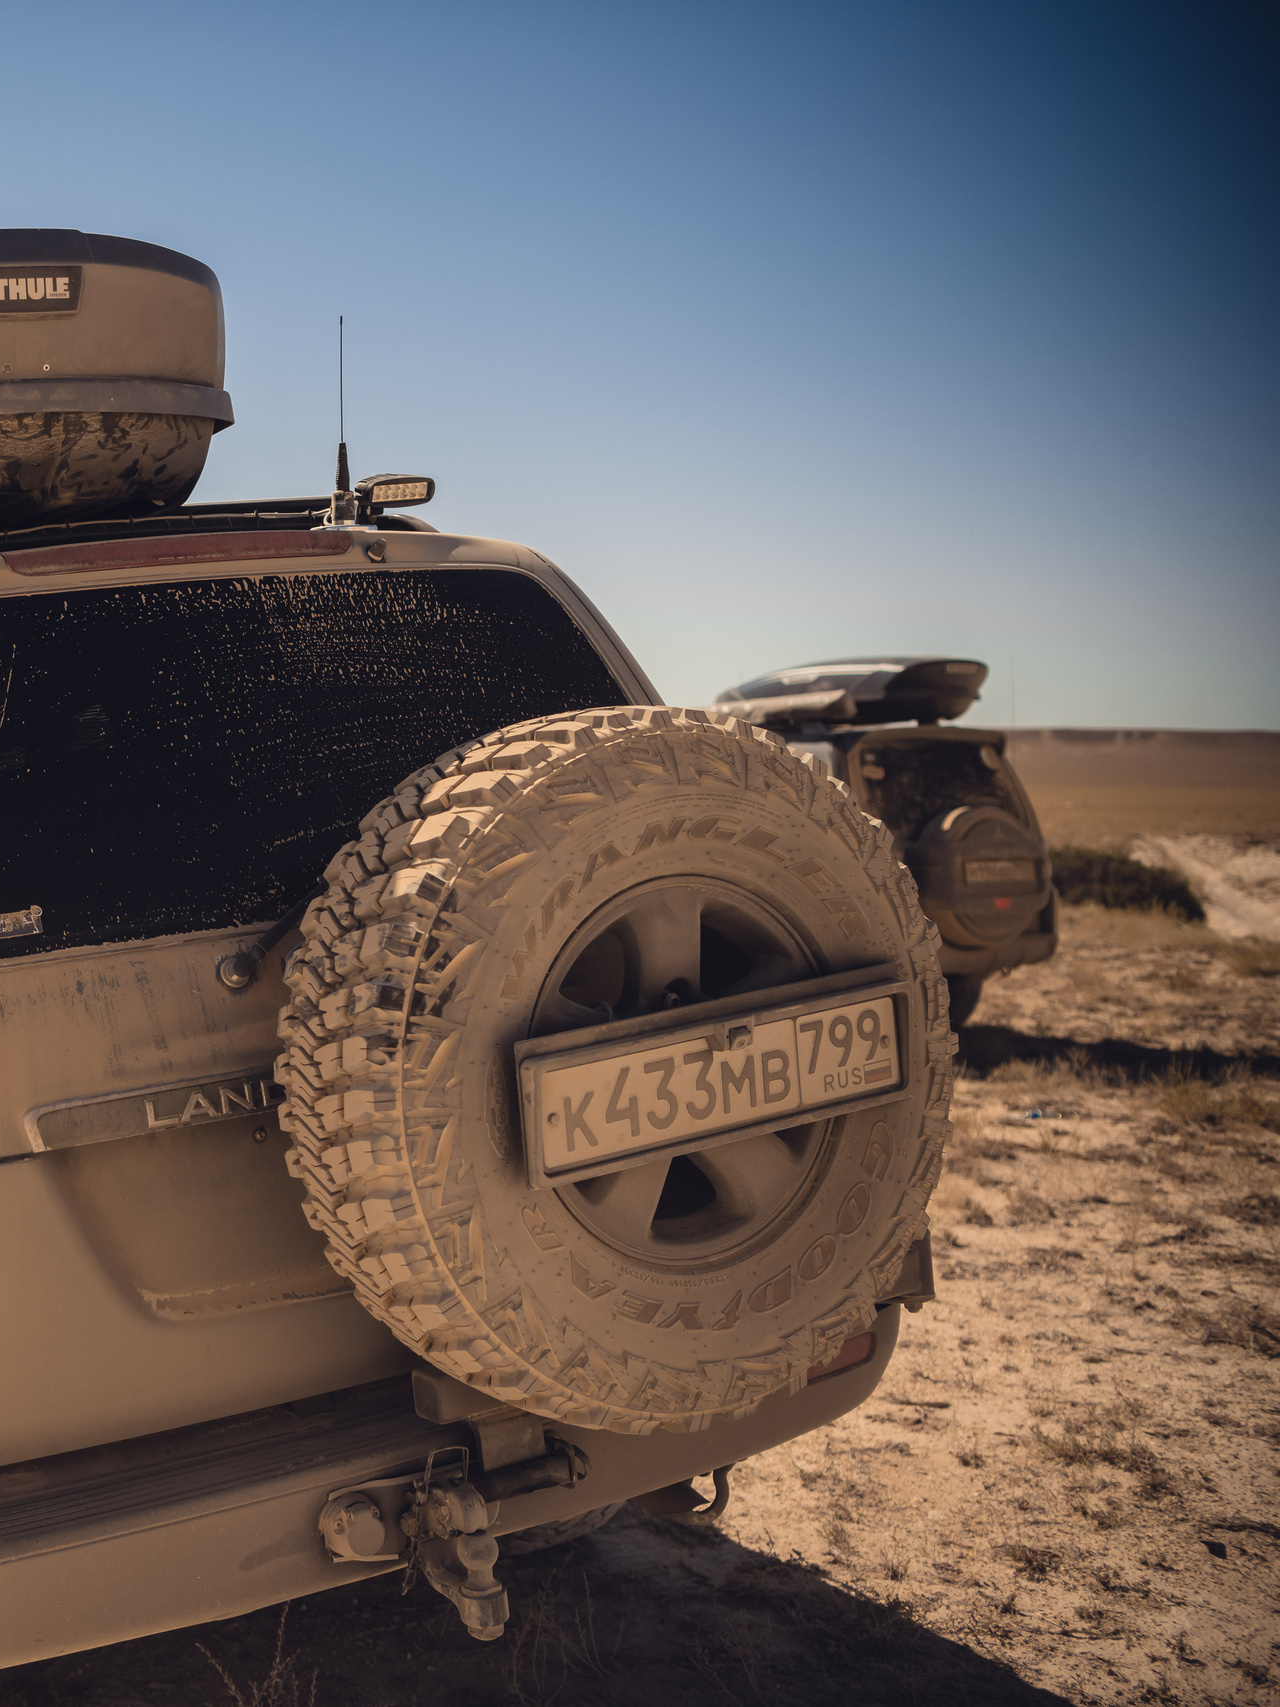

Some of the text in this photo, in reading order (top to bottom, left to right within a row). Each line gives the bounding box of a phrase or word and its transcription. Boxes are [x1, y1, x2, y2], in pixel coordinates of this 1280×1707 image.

[499, 814, 870, 999] WRANGLER
[799, 1009, 881, 1075] 799
[824, 1066, 863, 1093] RUS
[521, 1120, 895, 1332] GOODYEAR
